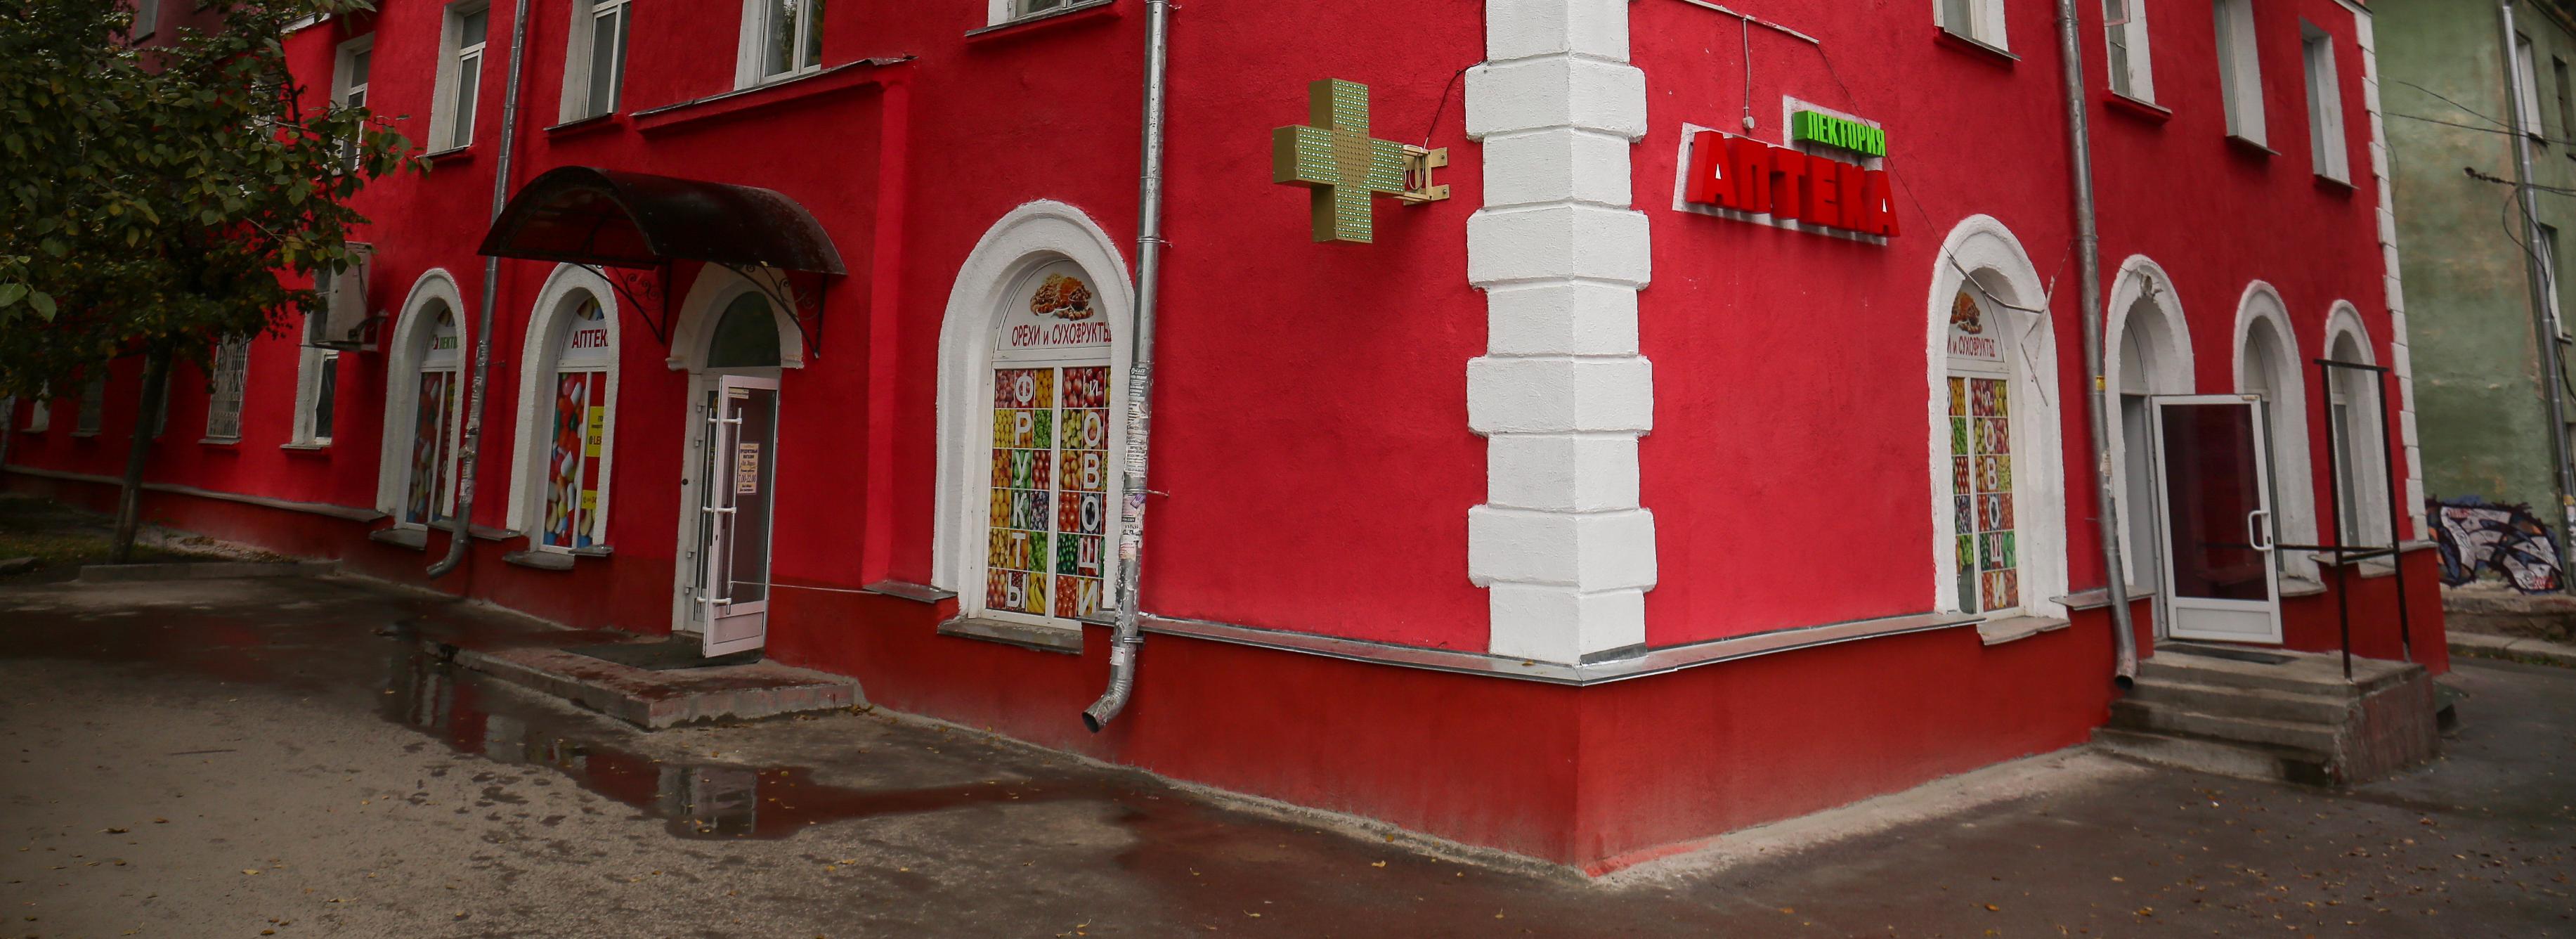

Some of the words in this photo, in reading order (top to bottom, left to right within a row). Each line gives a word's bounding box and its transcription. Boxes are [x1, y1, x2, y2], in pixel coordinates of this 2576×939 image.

[1806, 110, 1886, 157] ЛЕКТОРИЯ
[1688, 130, 1901, 238] АПТЕКА
[572, 329, 609, 349] АПТЕК
[1011, 325, 1041, 347] ОРЕХИ
[1043, 330, 1049, 345] и
[1052, 321, 1112, 344] СУХОФРУКТЫ
